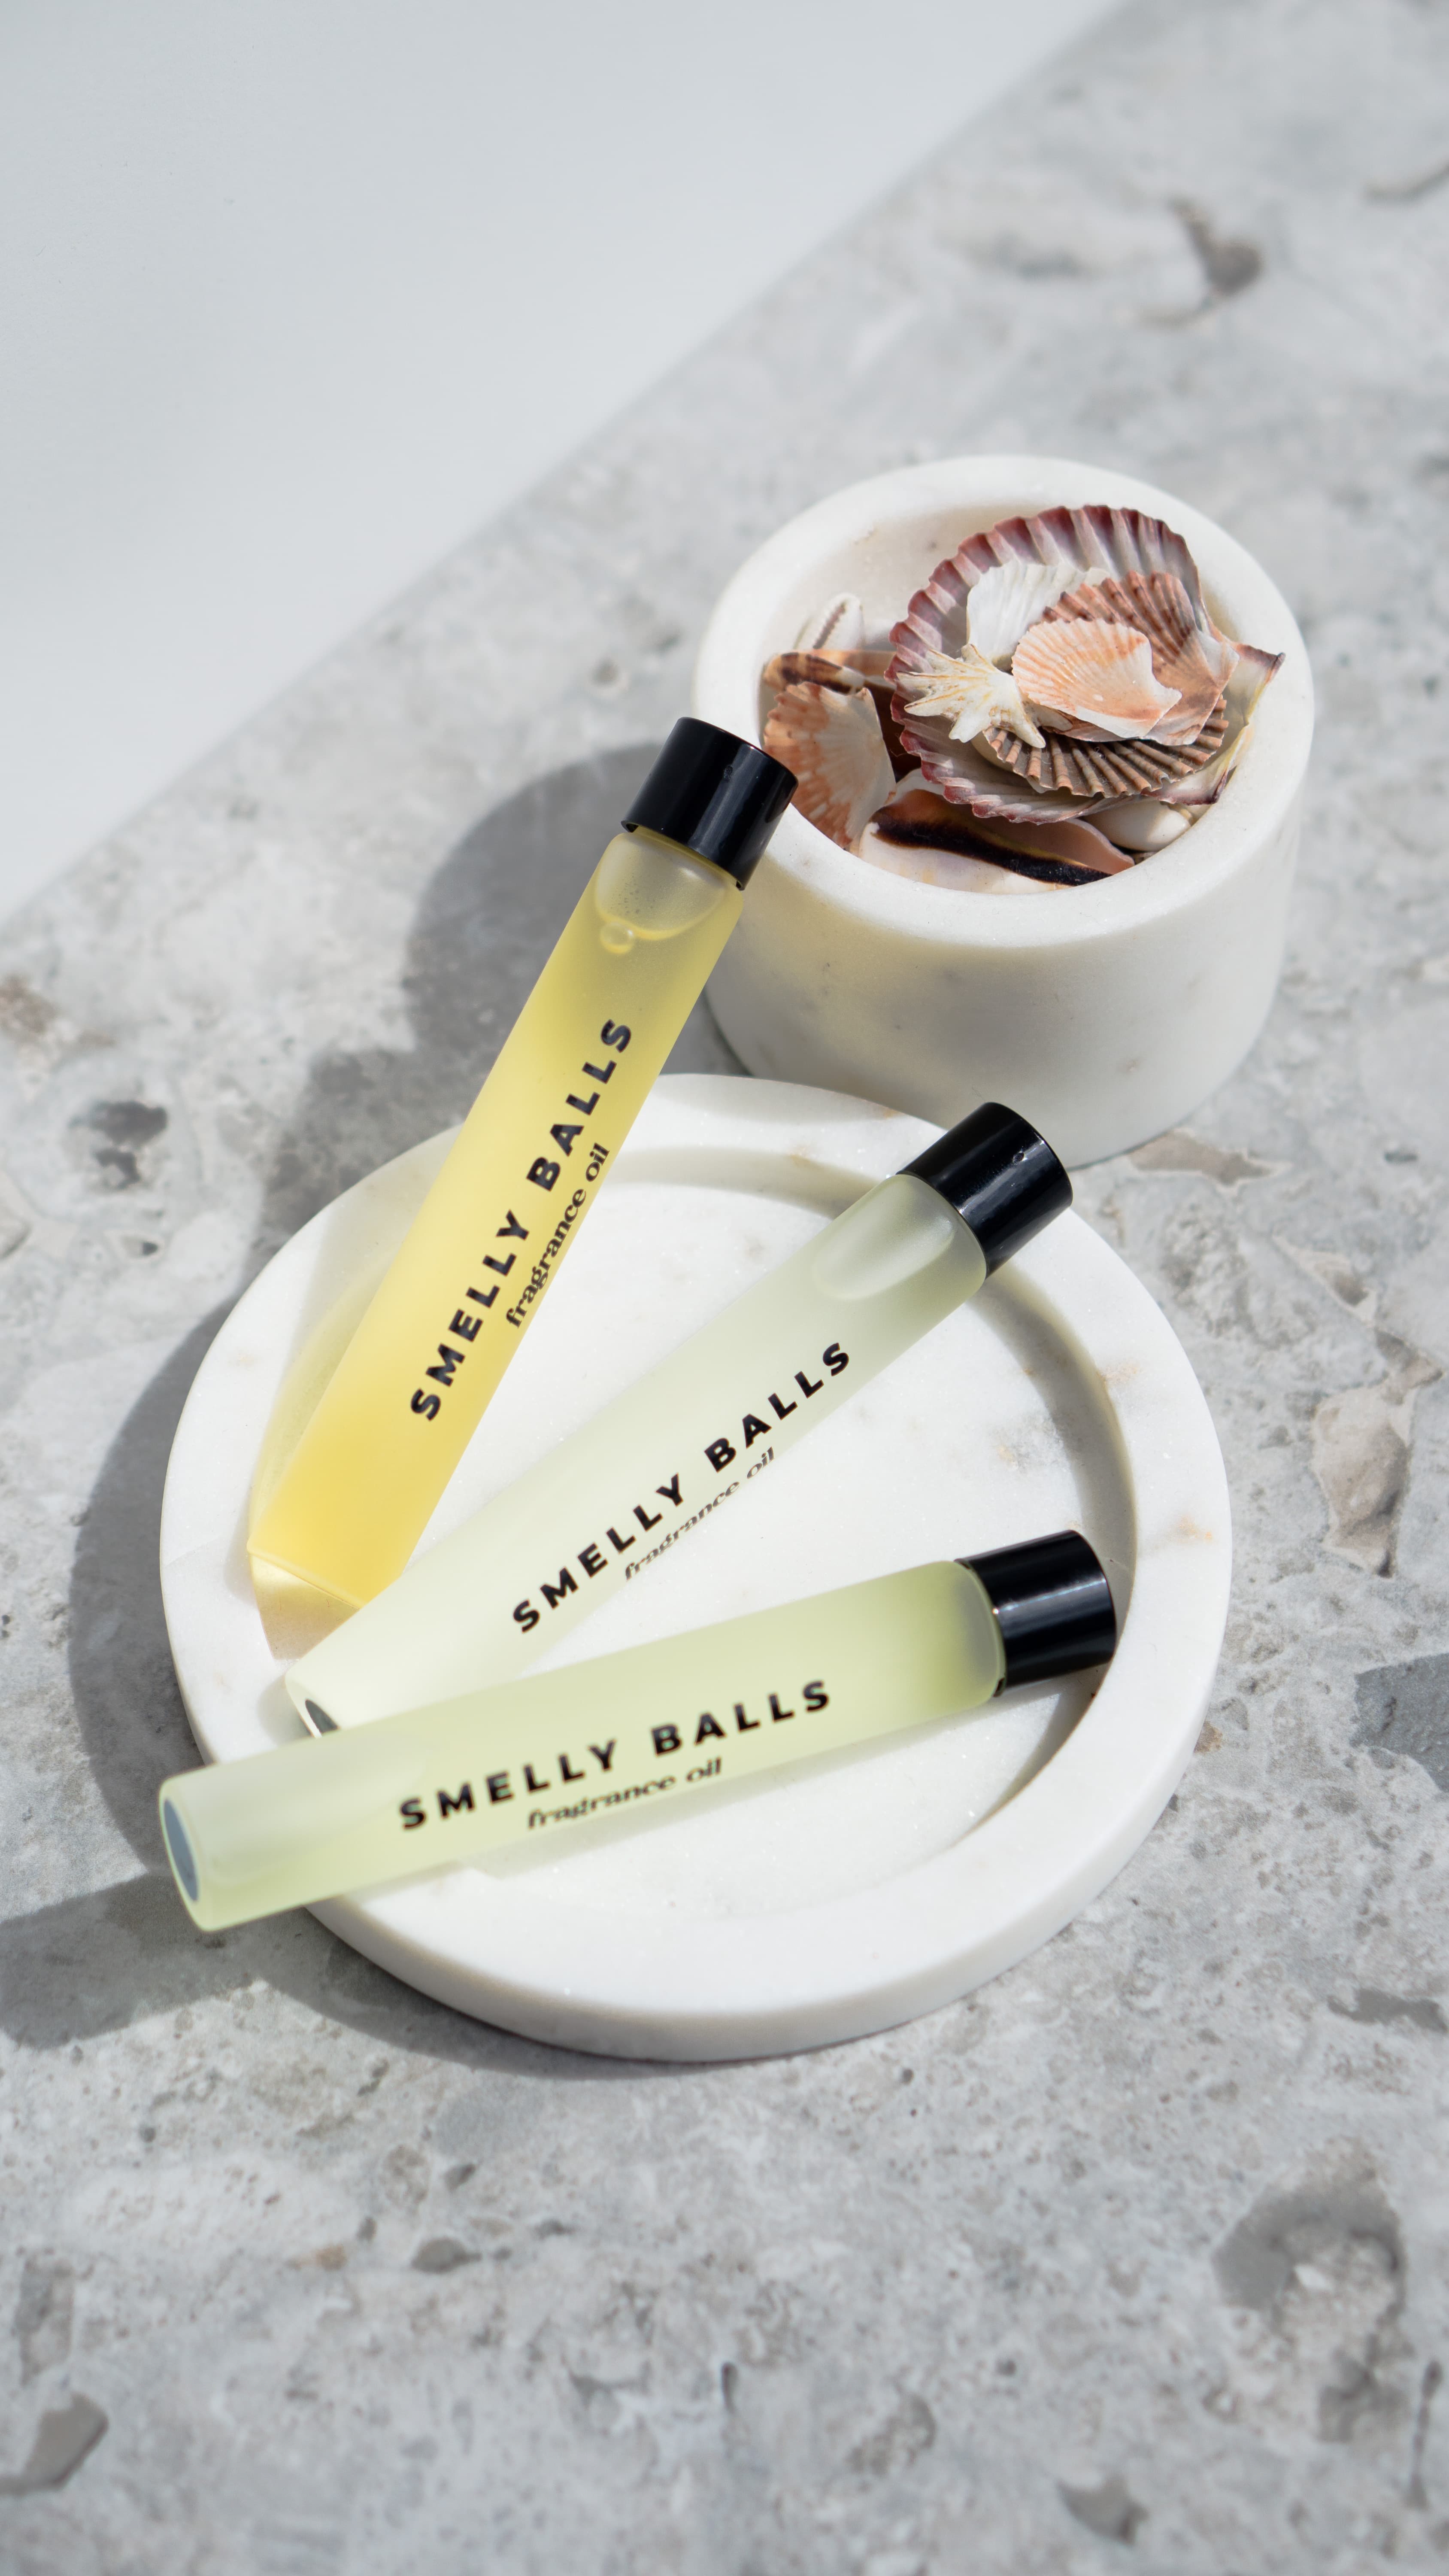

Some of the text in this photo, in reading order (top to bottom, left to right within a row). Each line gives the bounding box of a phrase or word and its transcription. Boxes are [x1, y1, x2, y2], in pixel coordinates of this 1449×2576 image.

[410, 1018, 632, 1422] SMELLY BALLS
[506, 1142, 610, 1329] fragrance oil
[512, 1342, 850, 1633] SMELLY BALLS
[624, 1447, 775, 1581] fragrance oil
[400, 1680, 830, 1829] SMELLY BALLS
[528, 1758, 722, 1829] fragrance oil
